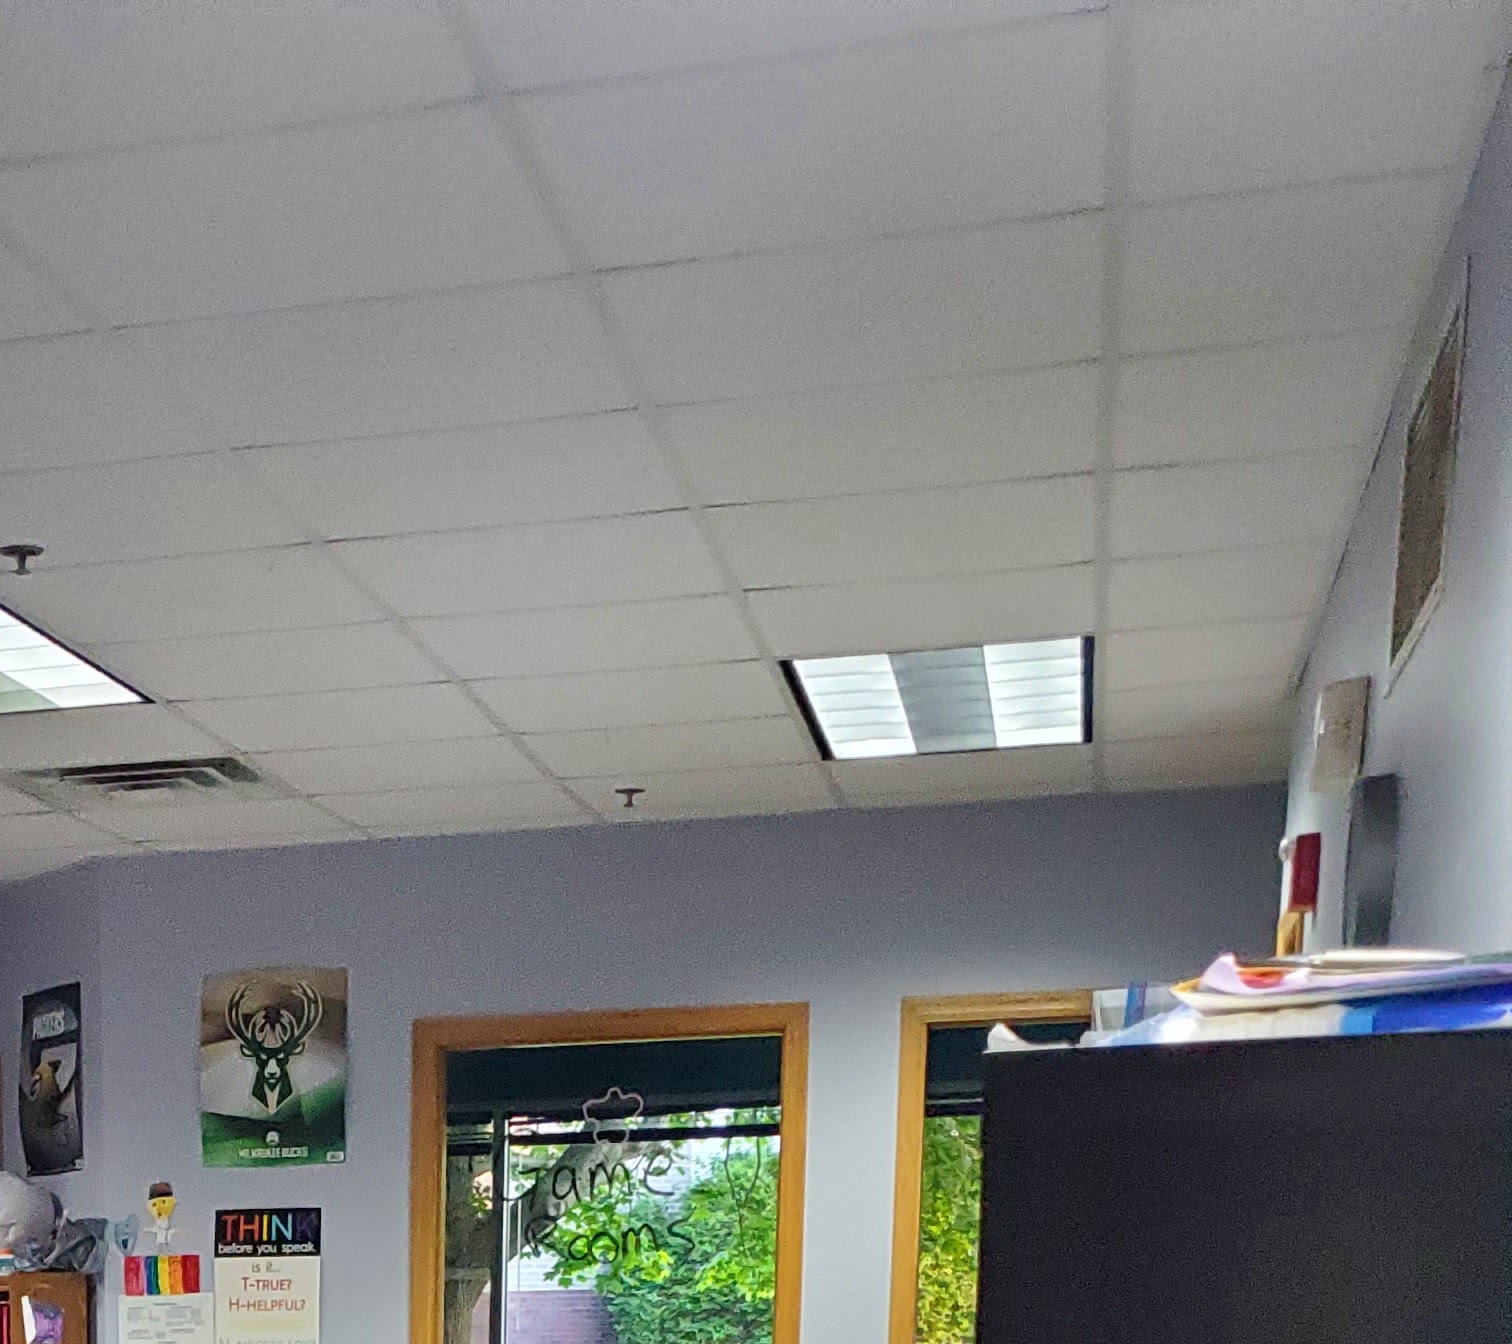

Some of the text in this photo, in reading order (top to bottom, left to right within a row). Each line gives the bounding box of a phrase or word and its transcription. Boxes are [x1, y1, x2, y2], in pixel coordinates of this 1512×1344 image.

[282, 1146, 309, 1158] BUCKS
[221, 1213, 317, 1242] THINK
[525, 1216, 696, 1264] Rooms
[218, 1243, 253, 1254] before
[257, 1244, 277, 1255] you
[252, 1263, 261, 1273] is
[241, 1277, 292, 1291] T-TRUE?
[229, 1298, 306, 1312] H-HELPFUL?
